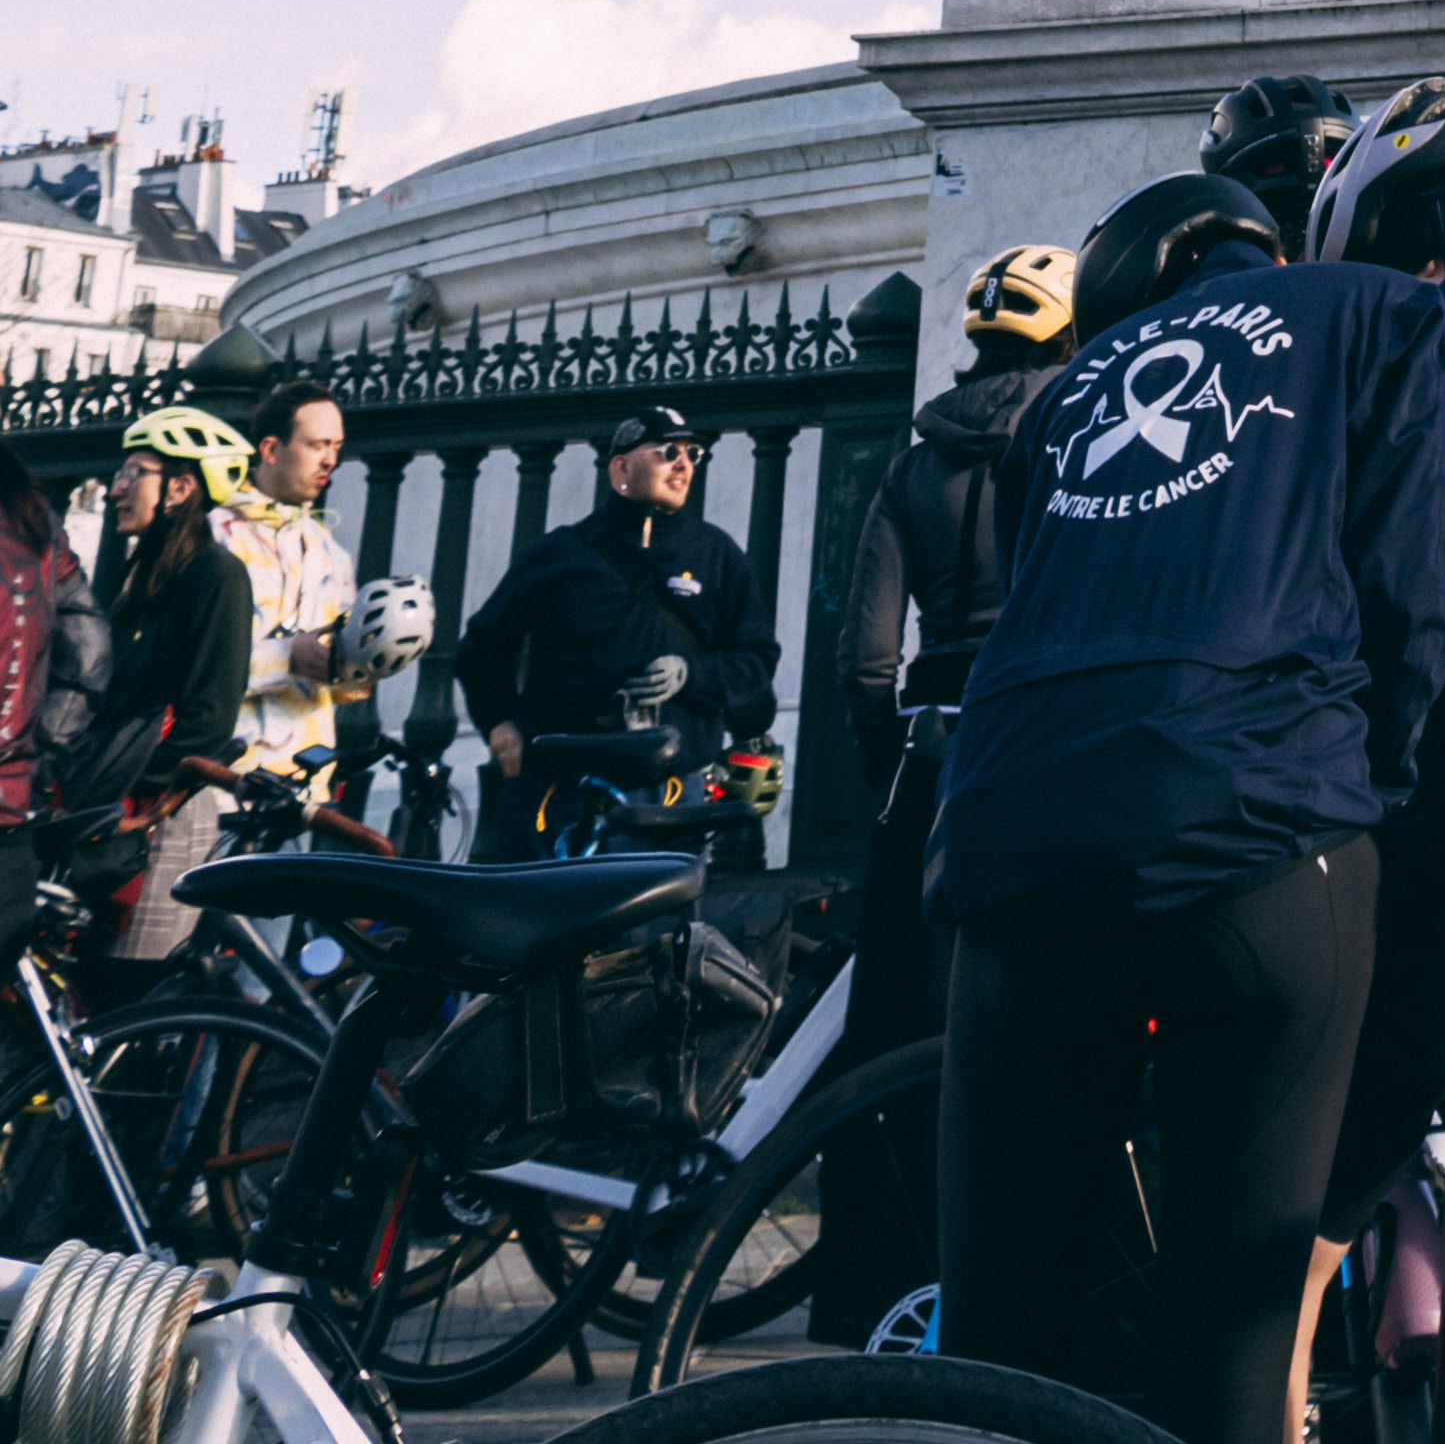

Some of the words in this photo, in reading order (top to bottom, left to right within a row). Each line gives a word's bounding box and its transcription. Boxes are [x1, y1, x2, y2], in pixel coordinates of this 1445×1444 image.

[1047, 488, 1104, 519] ONTRE
[1104, 494, 1133, 518] LE
[1138, 451, 1234, 511] CANCER
